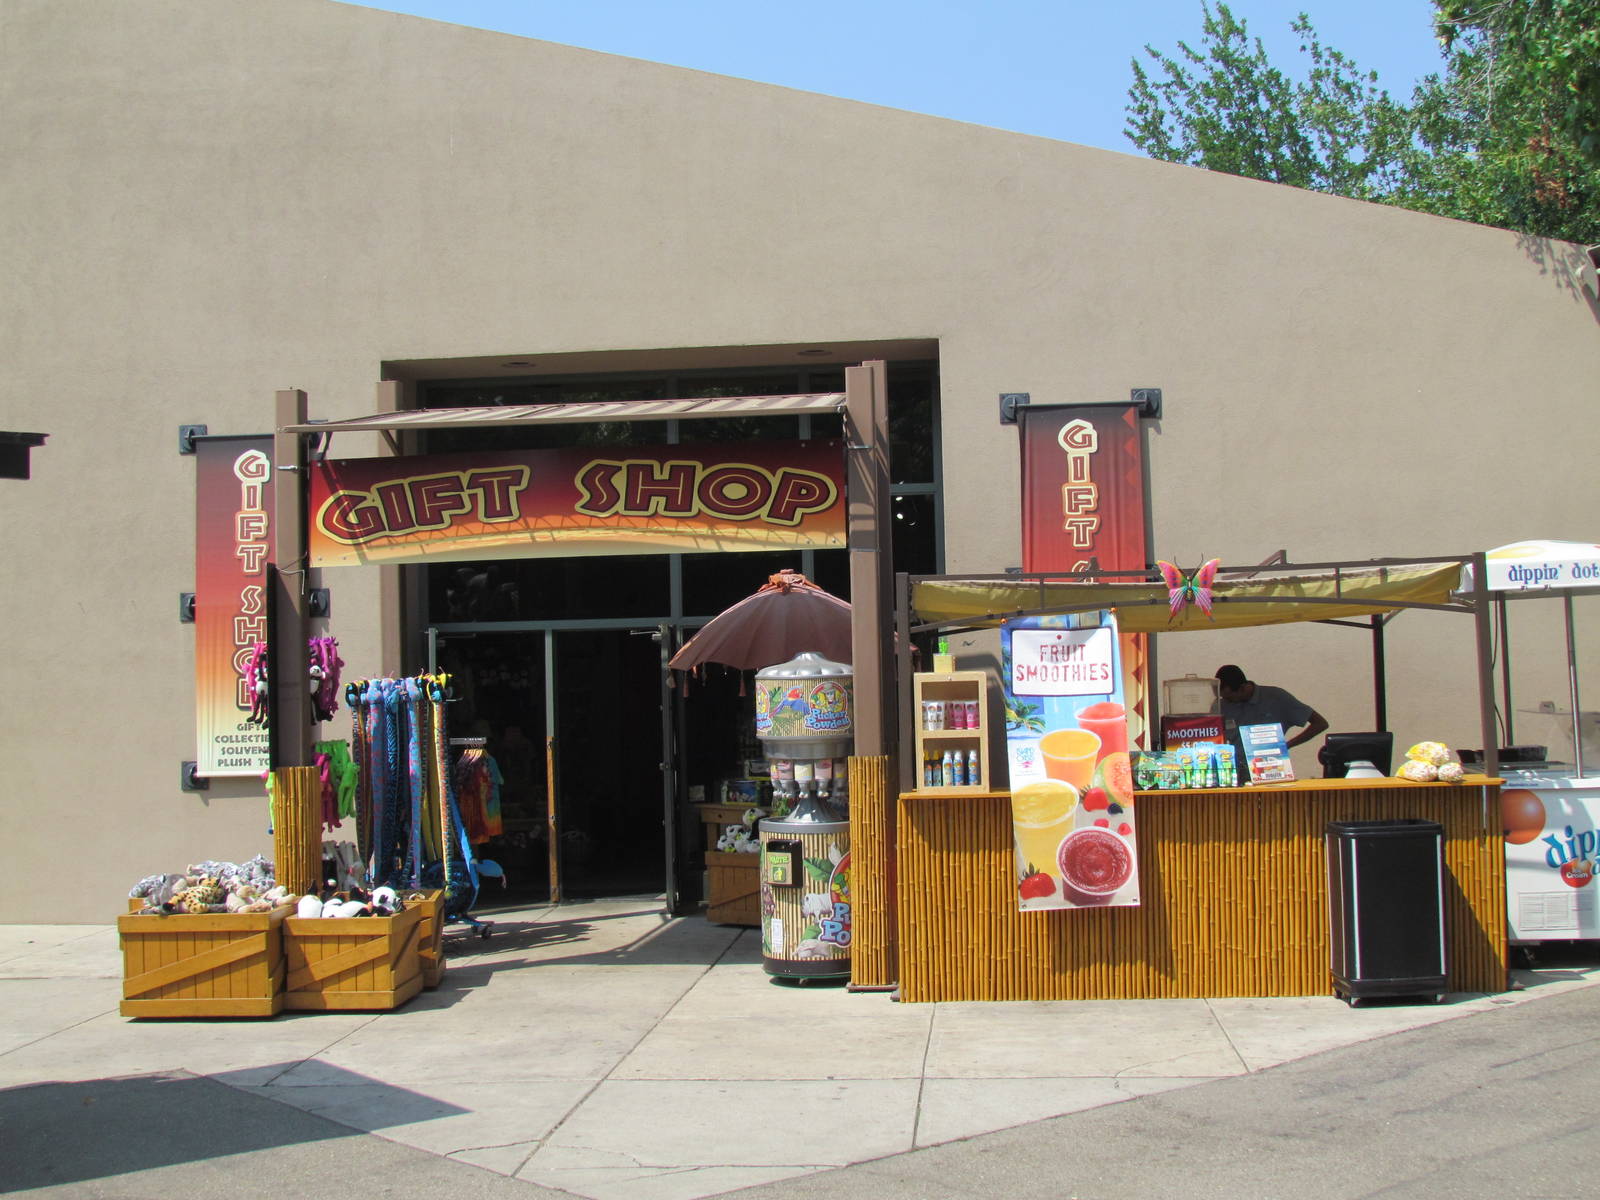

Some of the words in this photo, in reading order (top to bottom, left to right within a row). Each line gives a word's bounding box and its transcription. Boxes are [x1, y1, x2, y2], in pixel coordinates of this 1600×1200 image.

[1058, 419, 1099, 548] GIFT
[317, 465, 530, 545] GIFT
[575, 459, 837, 525] SHOP
[234, 449, 270, 575] GIFT
[1572, 562, 1600, 579] dot
[1040, 644, 1086, 662] FRUIT
[1016, 663, 1109, 682] SMOOTHIES
[1167, 727, 1219, 740] SMOOTHIES
[217, 758, 252, 767] PLUSH
